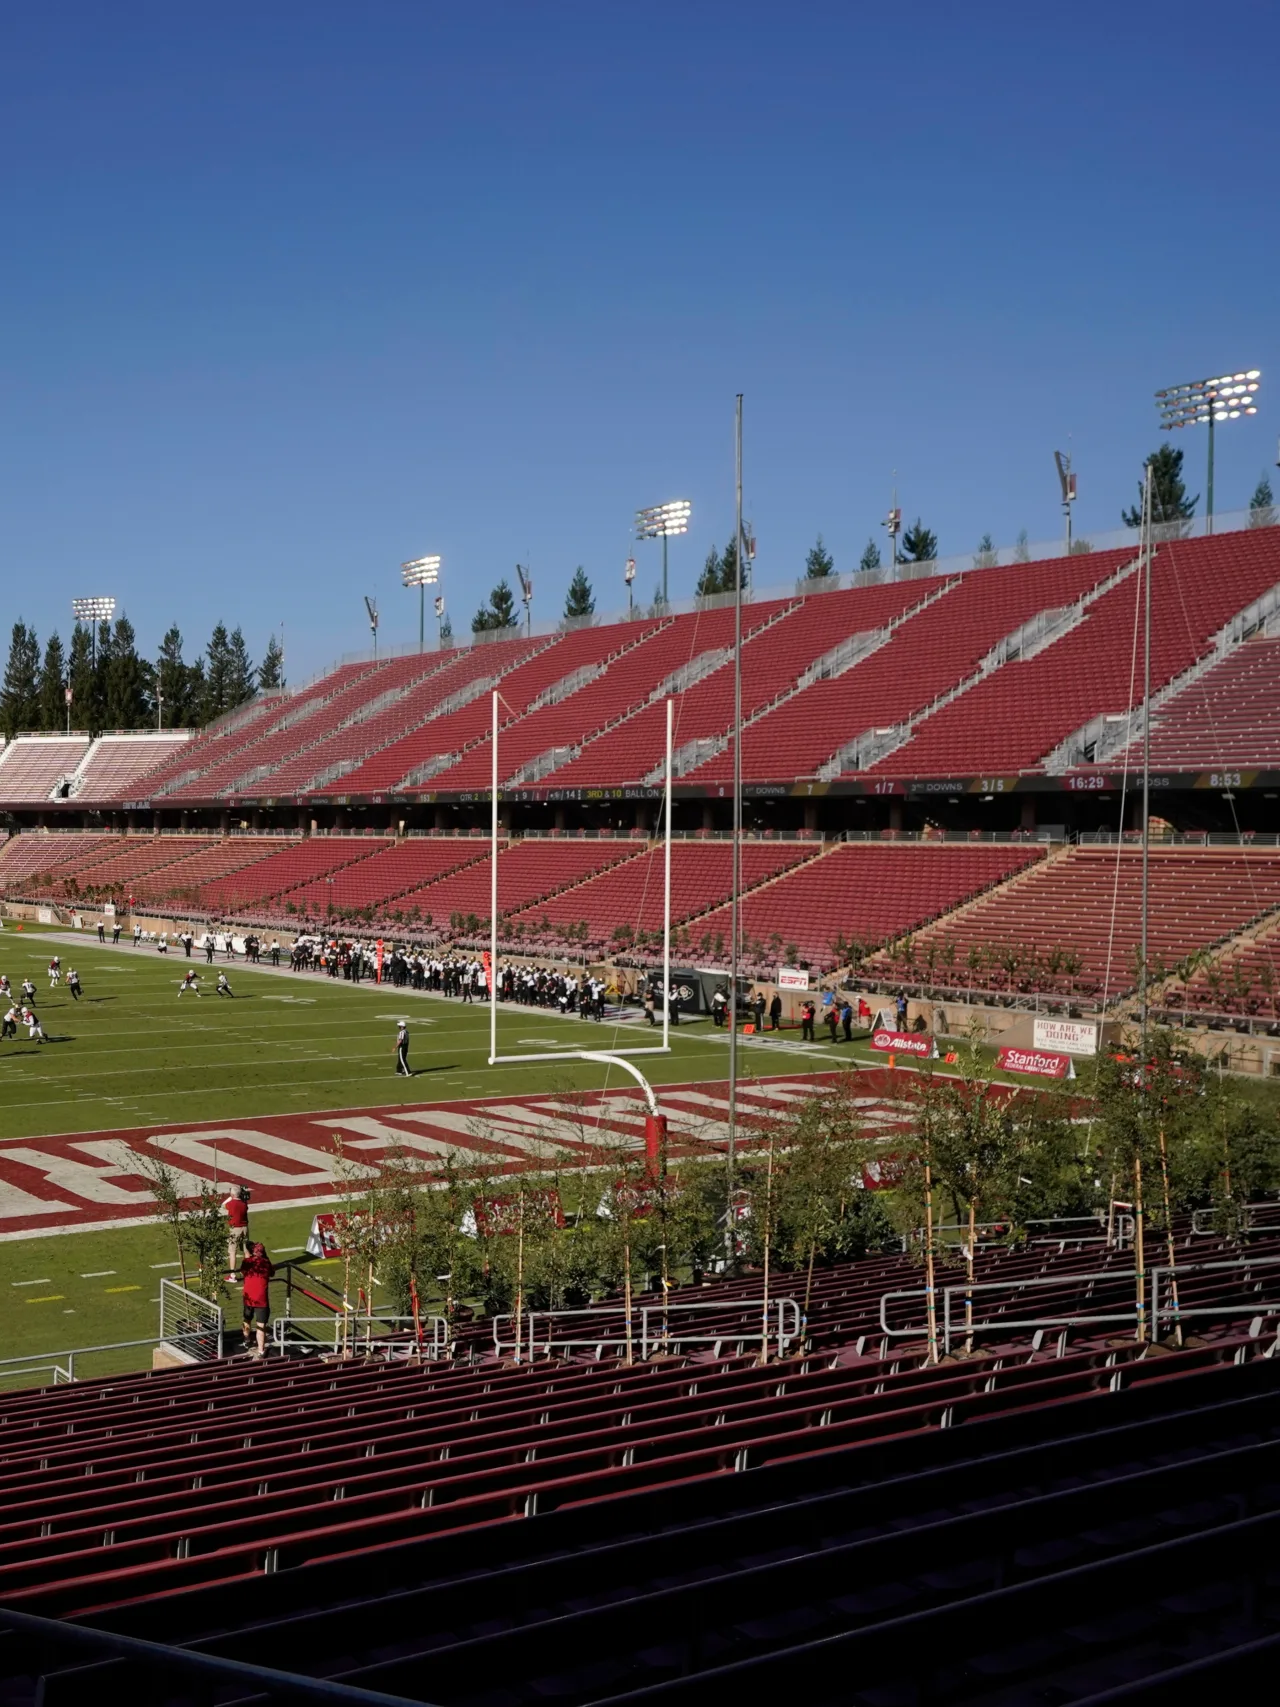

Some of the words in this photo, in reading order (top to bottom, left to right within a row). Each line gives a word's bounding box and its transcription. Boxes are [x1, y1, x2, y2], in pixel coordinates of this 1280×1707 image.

[1069, 777, 1104, 789] 16:29
[1136, 777, 1169, 787] POSS
[1210, 773, 1241, 787] 8:53
[756, 787, 785, 795] DOWNS
[807, 785, 813, 795] 7
[926, 782, 963, 791] DOWNS
[522, 791, 527, 799] 9
[566, 791, 575, 799] 14
[625, 789, 644, 798] BALL
[647, 789, 659, 797] ON
[718, 787, 724, 797] 8
[780, 976, 807, 985] ESPN
[1037, 1021, 1057, 1030] HOW
[1059, 1024, 1077, 1033] ARE
[1079, 1026, 1093, 1035] WE
[889, 1038, 927, 1051] Allstate
[1006, 1050, 1060, 1069] Stanford
[1004, 1062, 1024, 1070] FEDERAL
